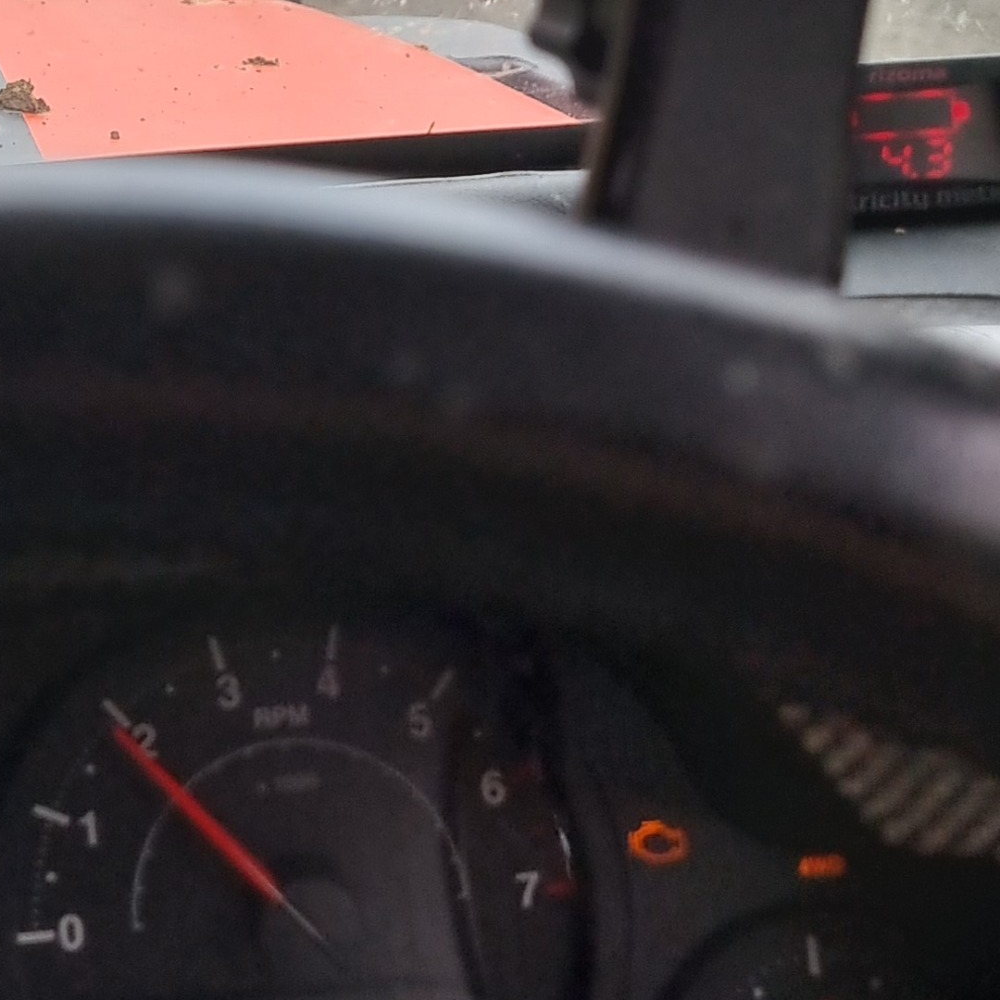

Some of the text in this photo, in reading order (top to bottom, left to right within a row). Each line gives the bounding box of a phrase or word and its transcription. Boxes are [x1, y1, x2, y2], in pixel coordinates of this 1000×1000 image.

[215, 674, 242, 712] 3
[408, 702, 433, 739] 5
[130, 722, 160, 759] 2
[481, 770, 506, 805] 6
[78, 811, 98, 848] 1
[515, 871, 539, 909] 7
[58, 914, 85, 952] 0
